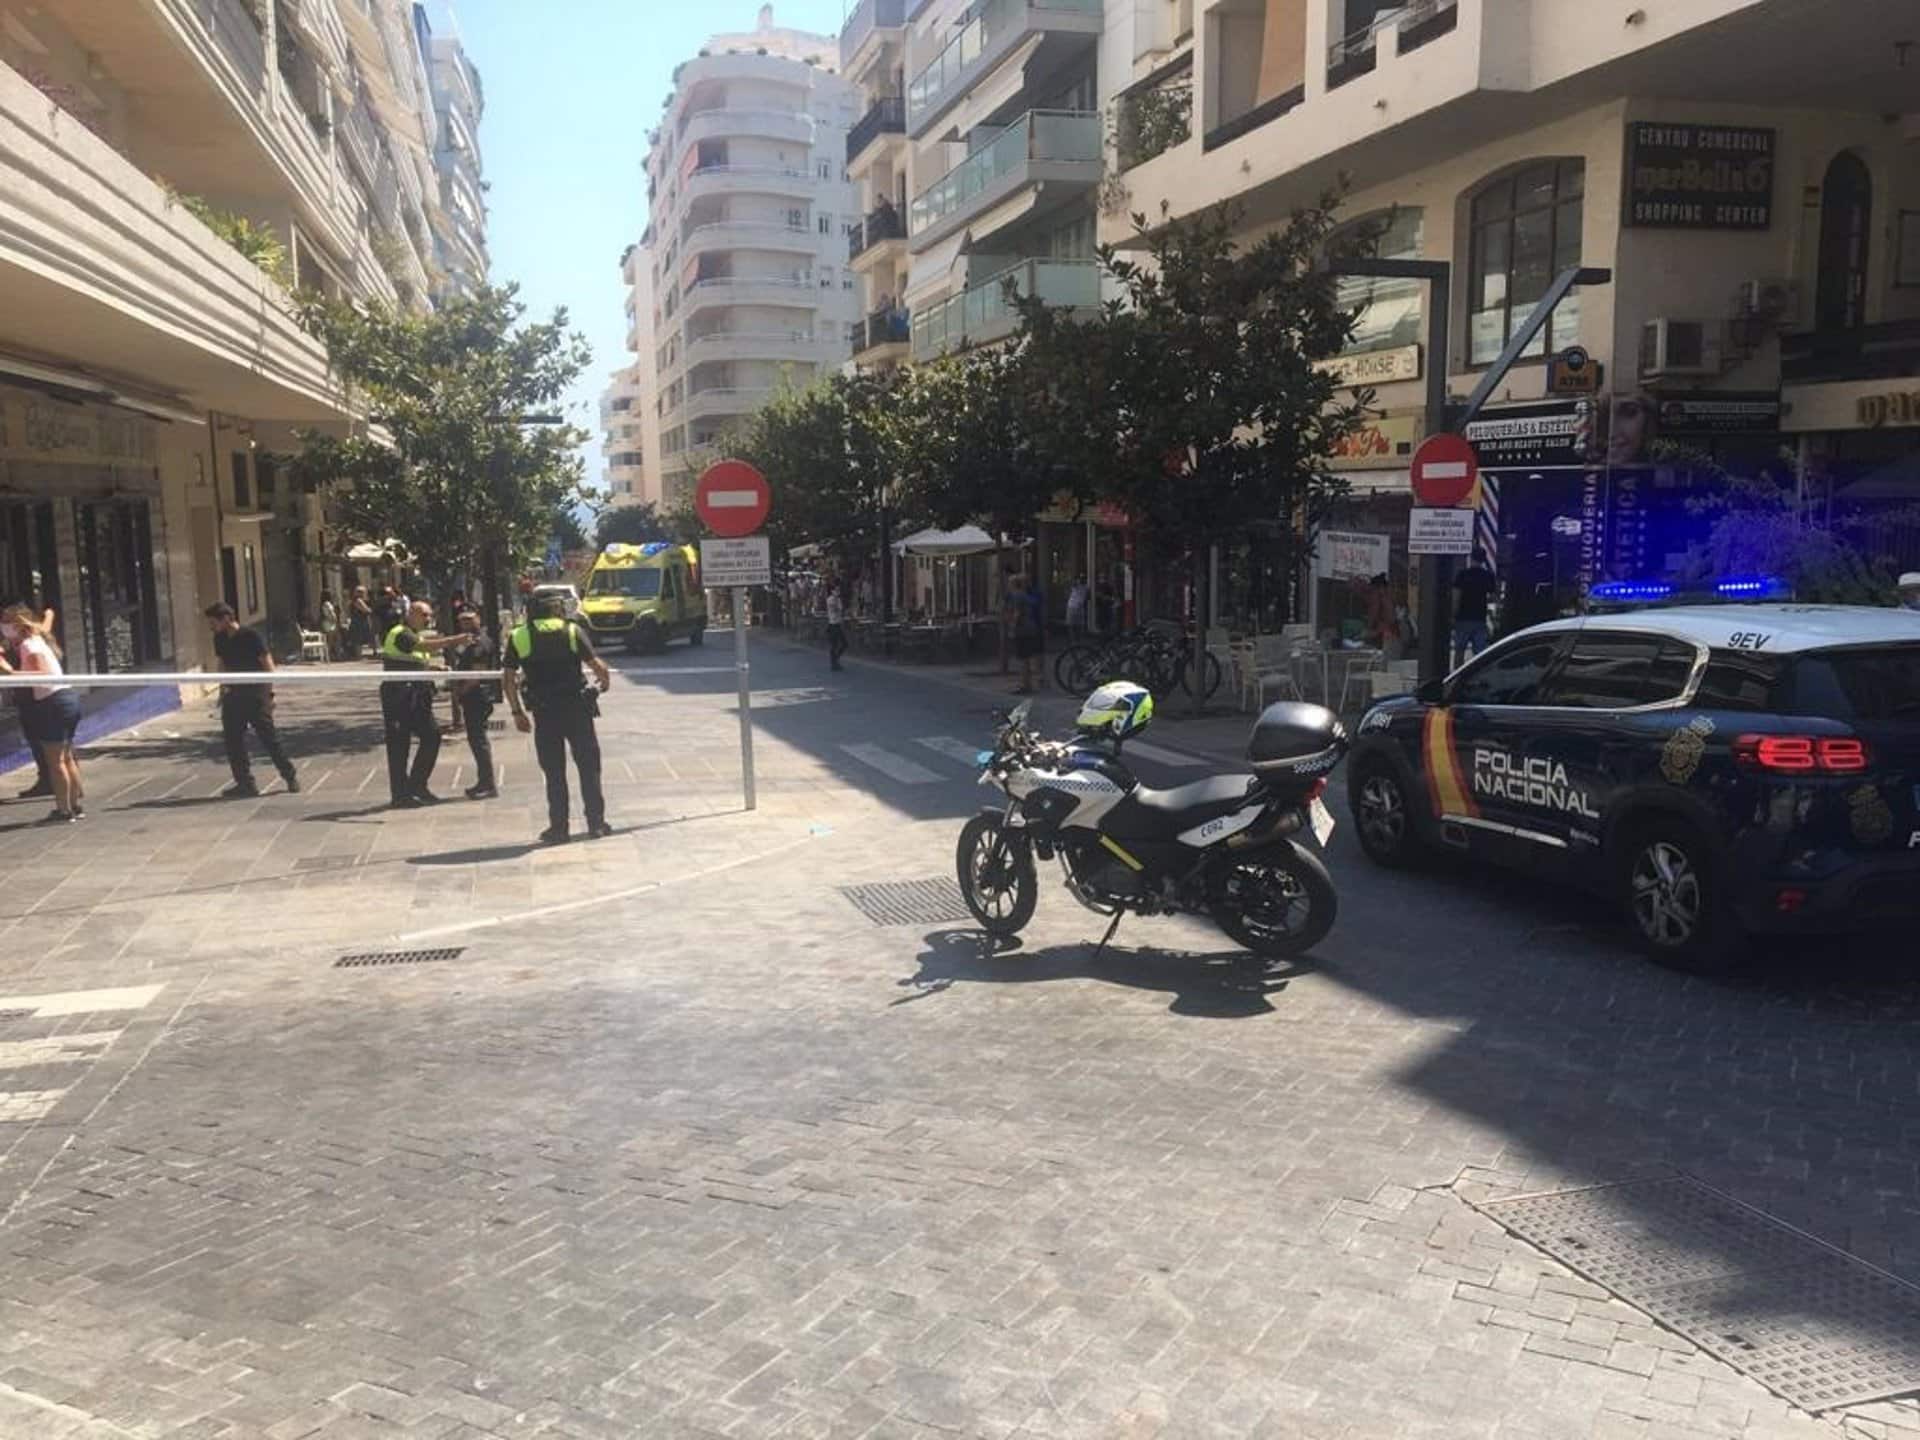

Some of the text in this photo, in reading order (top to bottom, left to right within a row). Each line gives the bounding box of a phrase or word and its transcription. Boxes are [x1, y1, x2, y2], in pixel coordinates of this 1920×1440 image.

[1639, 128, 1768, 152] CENTRO COMERCIAL
[1635, 202, 1767, 224] SHOPPING CENTER
[1531, 422, 1538, 434] &
[1728, 631, 1771, 649] 9EV
[1475, 748, 1569, 787] POLICÍA
[1475, 771, 1600, 819] NACIONAL
